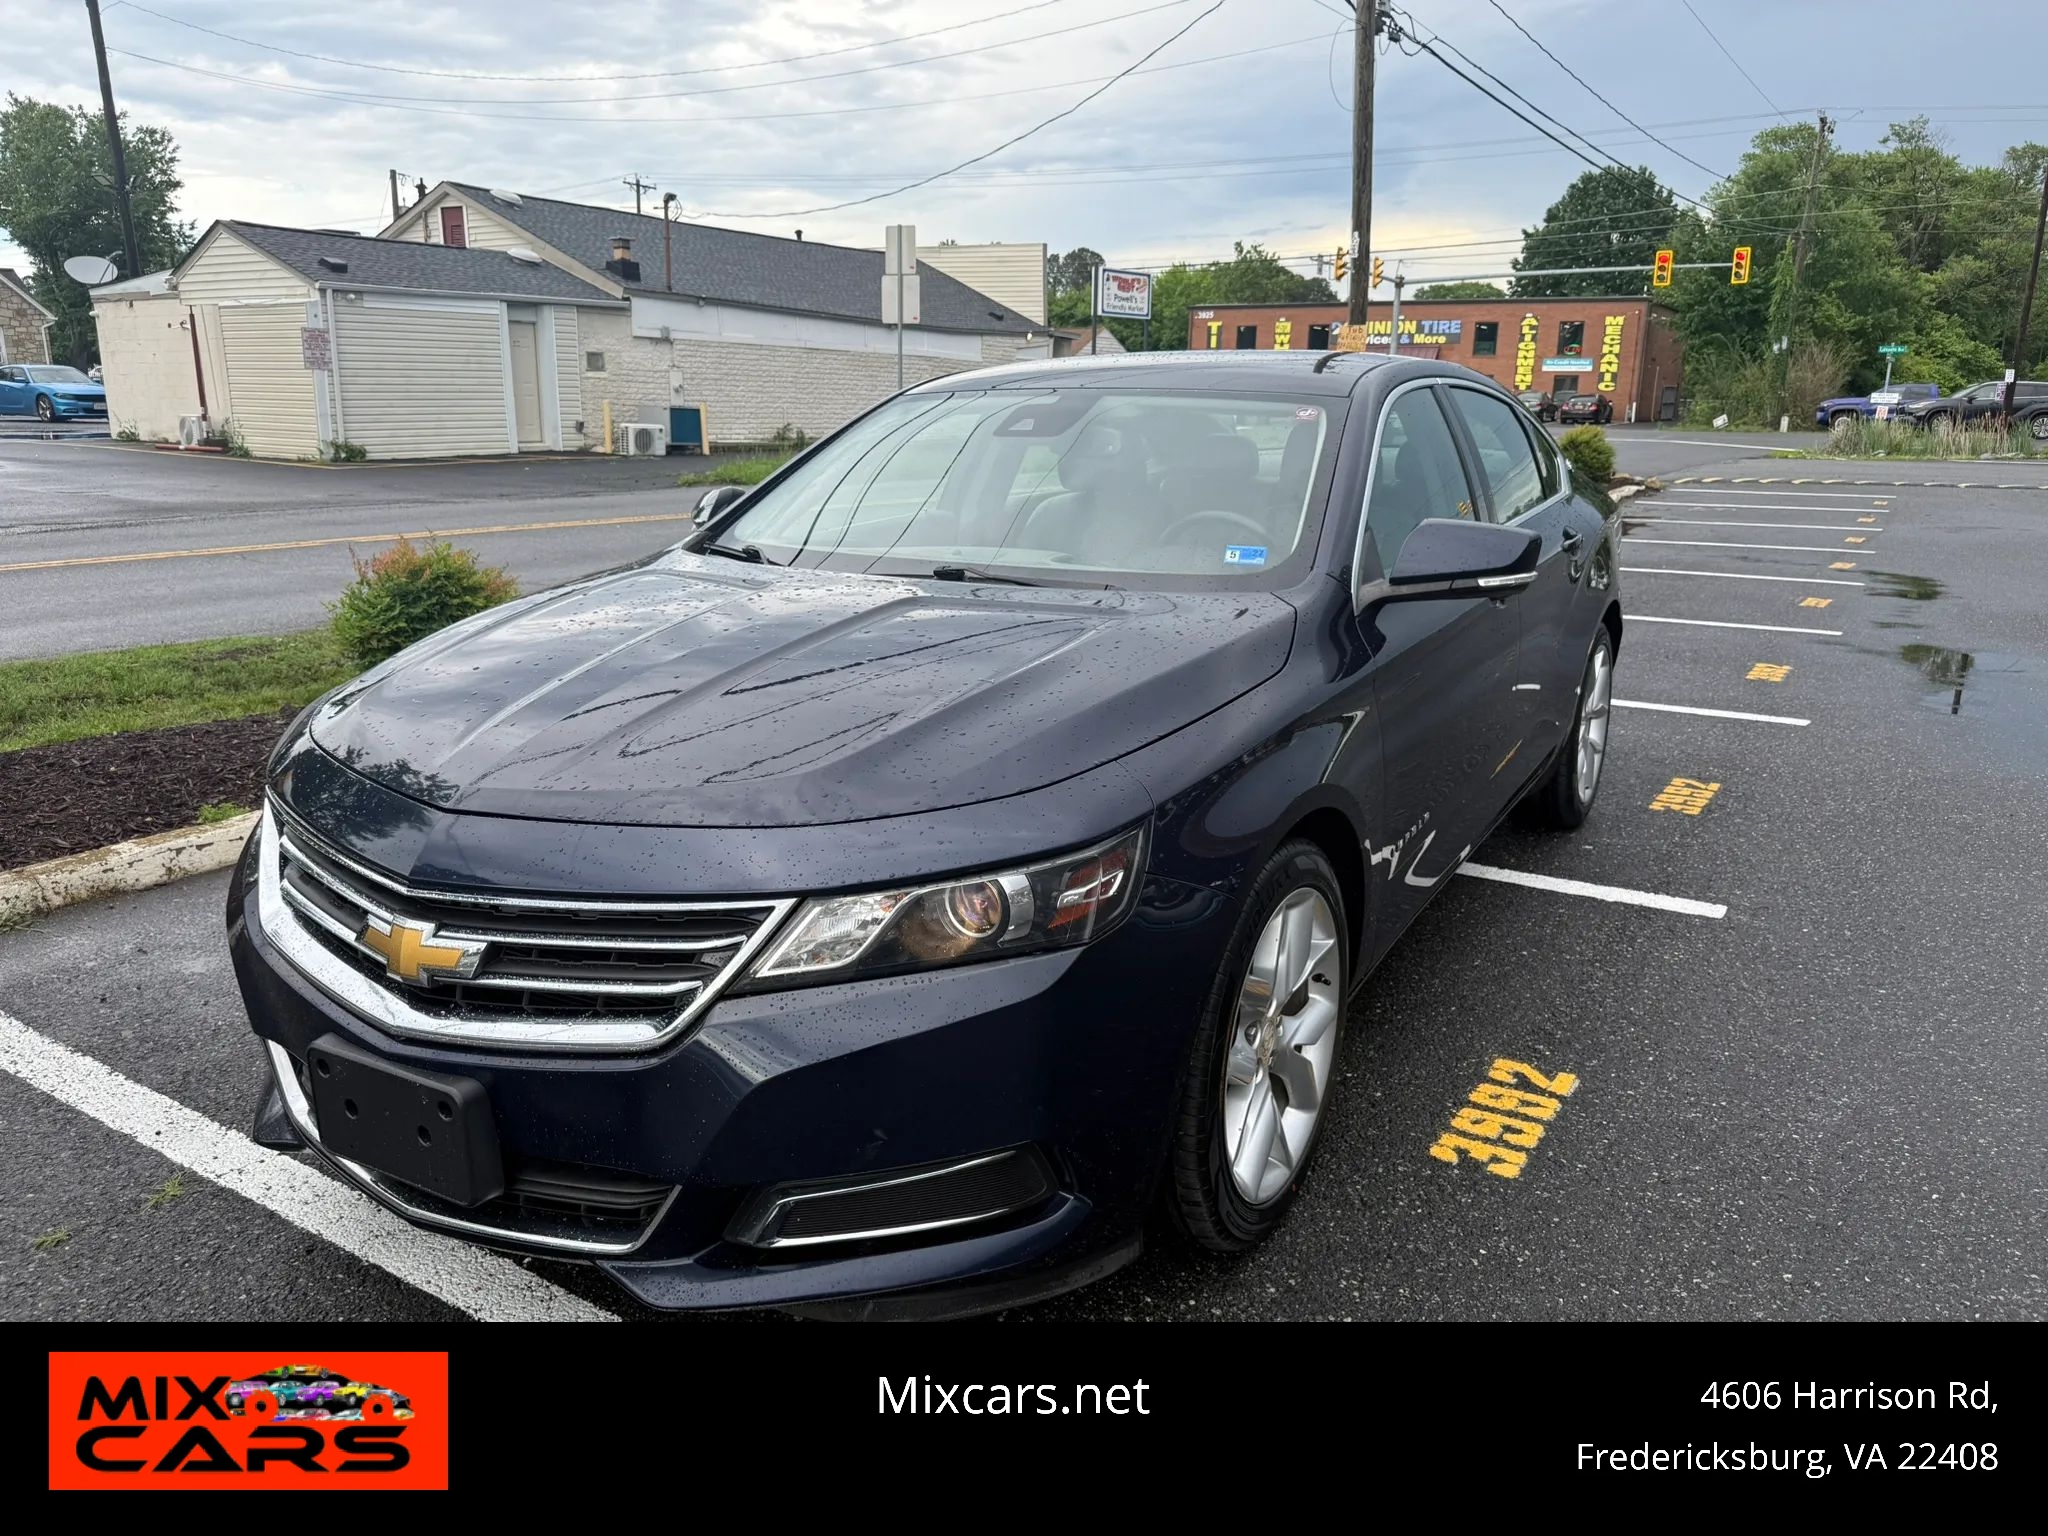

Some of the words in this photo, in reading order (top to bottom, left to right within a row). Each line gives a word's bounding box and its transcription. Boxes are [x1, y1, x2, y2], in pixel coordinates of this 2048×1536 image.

[1413, 333, 1447, 345] More
[1421, 320, 1461, 334] TIRE
[1514, 316, 1539, 391] ALIGNMENT
[1597, 315, 1625, 391] MECHANIC
[1429, 1057, 1580, 1180] 3992
